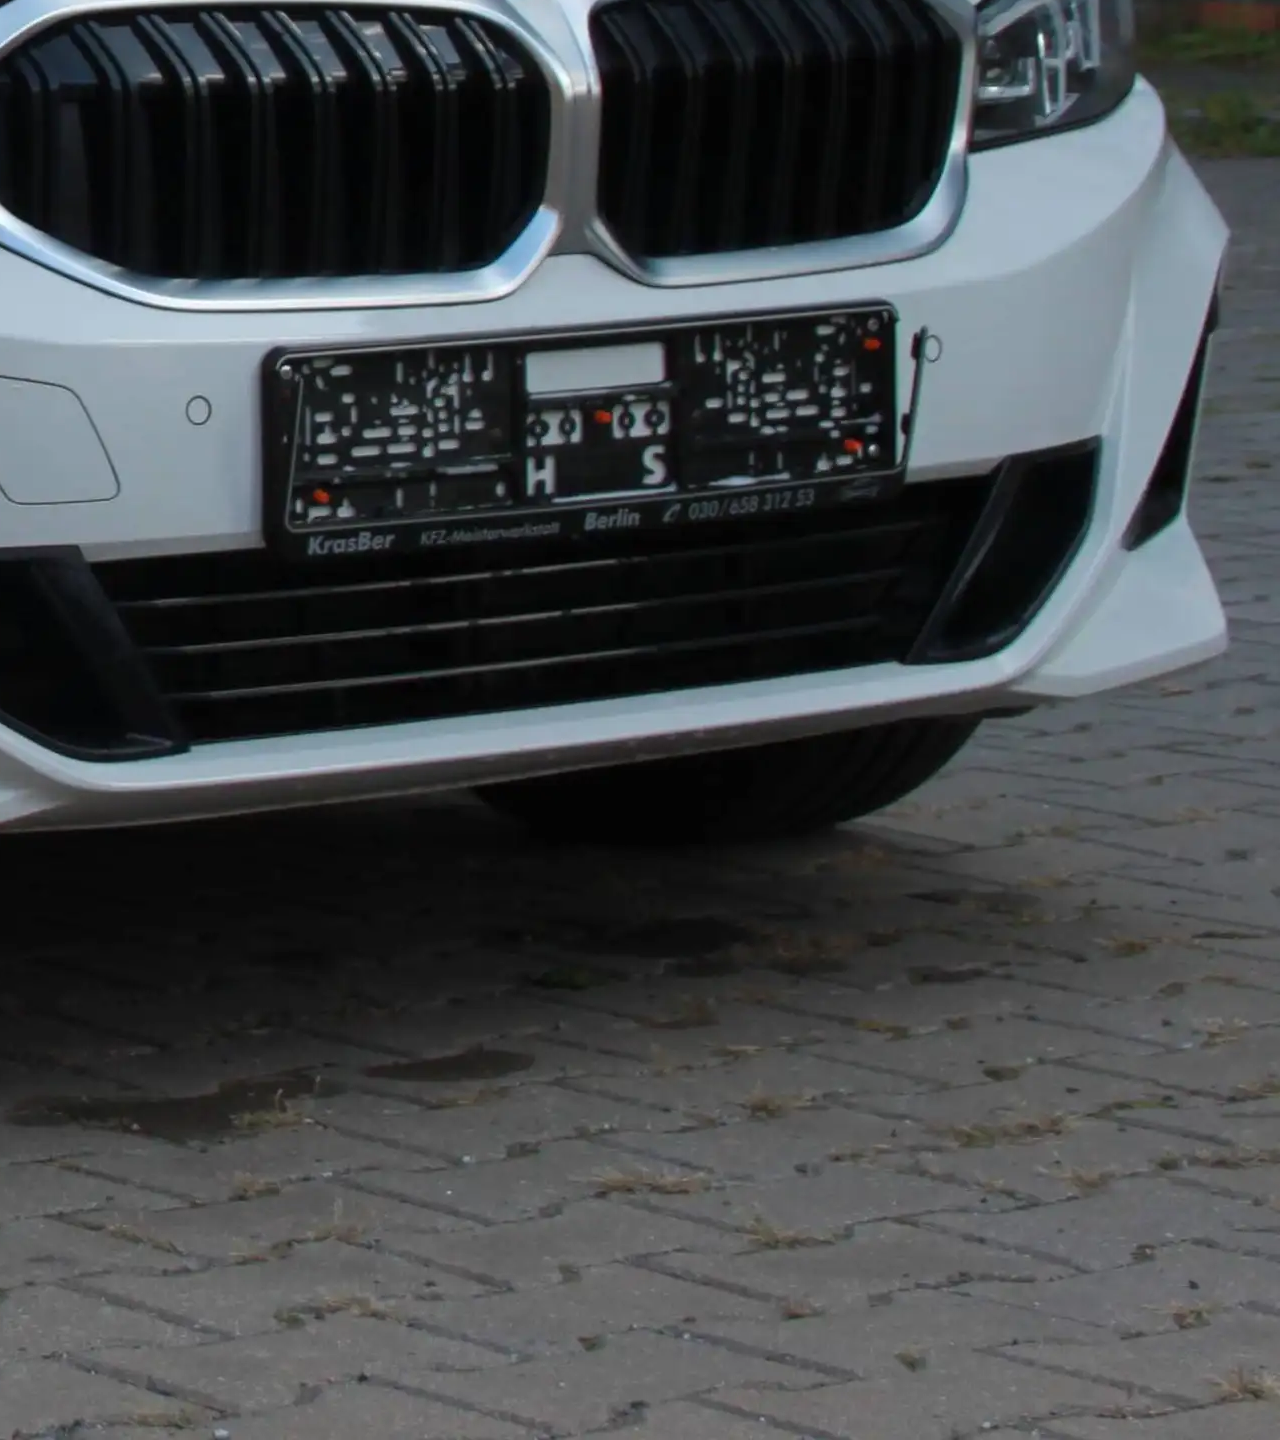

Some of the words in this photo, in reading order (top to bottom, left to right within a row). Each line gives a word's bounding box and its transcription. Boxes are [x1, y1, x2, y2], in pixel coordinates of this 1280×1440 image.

[526, 454, 556, 498] H
[641, 444, 667, 485] S
[307, 531, 396, 556] KrasBer
[583, 508, 641, 532] Berlin
